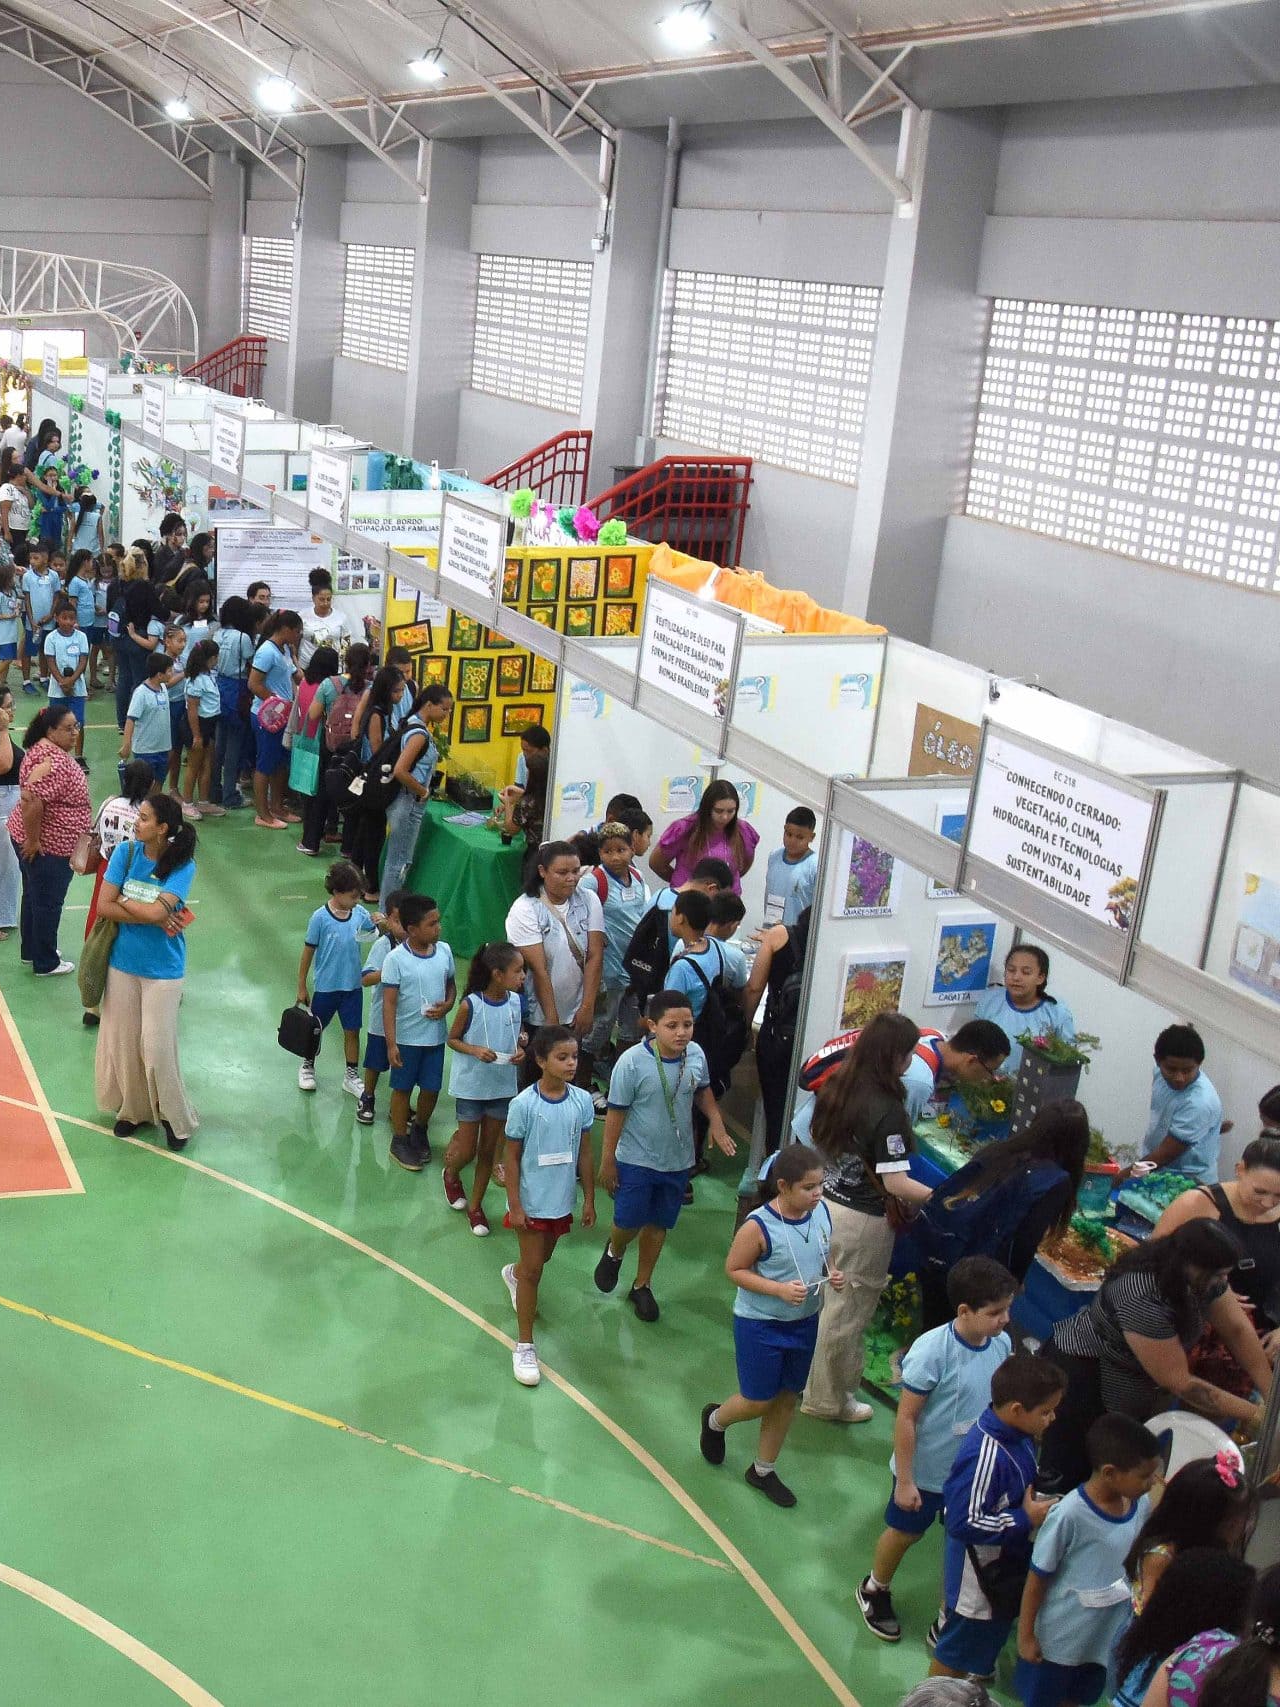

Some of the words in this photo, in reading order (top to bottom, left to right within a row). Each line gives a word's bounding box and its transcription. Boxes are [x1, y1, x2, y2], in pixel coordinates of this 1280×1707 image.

[651, 645, 667, 660] FORMA
[668, 654, 675, 664] DE
[675, 657, 710, 682] PRESERVAÇÃO
[654, 630, 683, 653] FABRICAÇÃO
[684, 645, 691, 655] DE
[709, 659, 724, 671] COMO
[690, 631, 697, 642] DE
[697, 634, 710, 648] ÓLEO
[711, 641, 725, 656] PARA
[659, 665, 677, 682] BIOMAS
[1053, 770, 1063, 781] EC
[1006, 771, 1065, 804] CONHECENDO
[1066, 797, 1073, 808] O
[1074, 801, 1121, 831] CERRADO:
[992, 806, 1050, 841] HIDROGRAFIA
[1051, 834, 1057, 846] E
[1059, 836, 1123, 877] TECNOLOGIAS
[1015, 796, 1069, 832] VEGETAÇÃO,
[1071, 822, 1103, 848] CLIMA,
[1006, 854, 1091, 907] SUSTENTABILIDADE
[1021, 841, 1041, 860] COM
[1041, 849, 1073, 876] VISTAS
[1074, 867, 1081, 881] A
